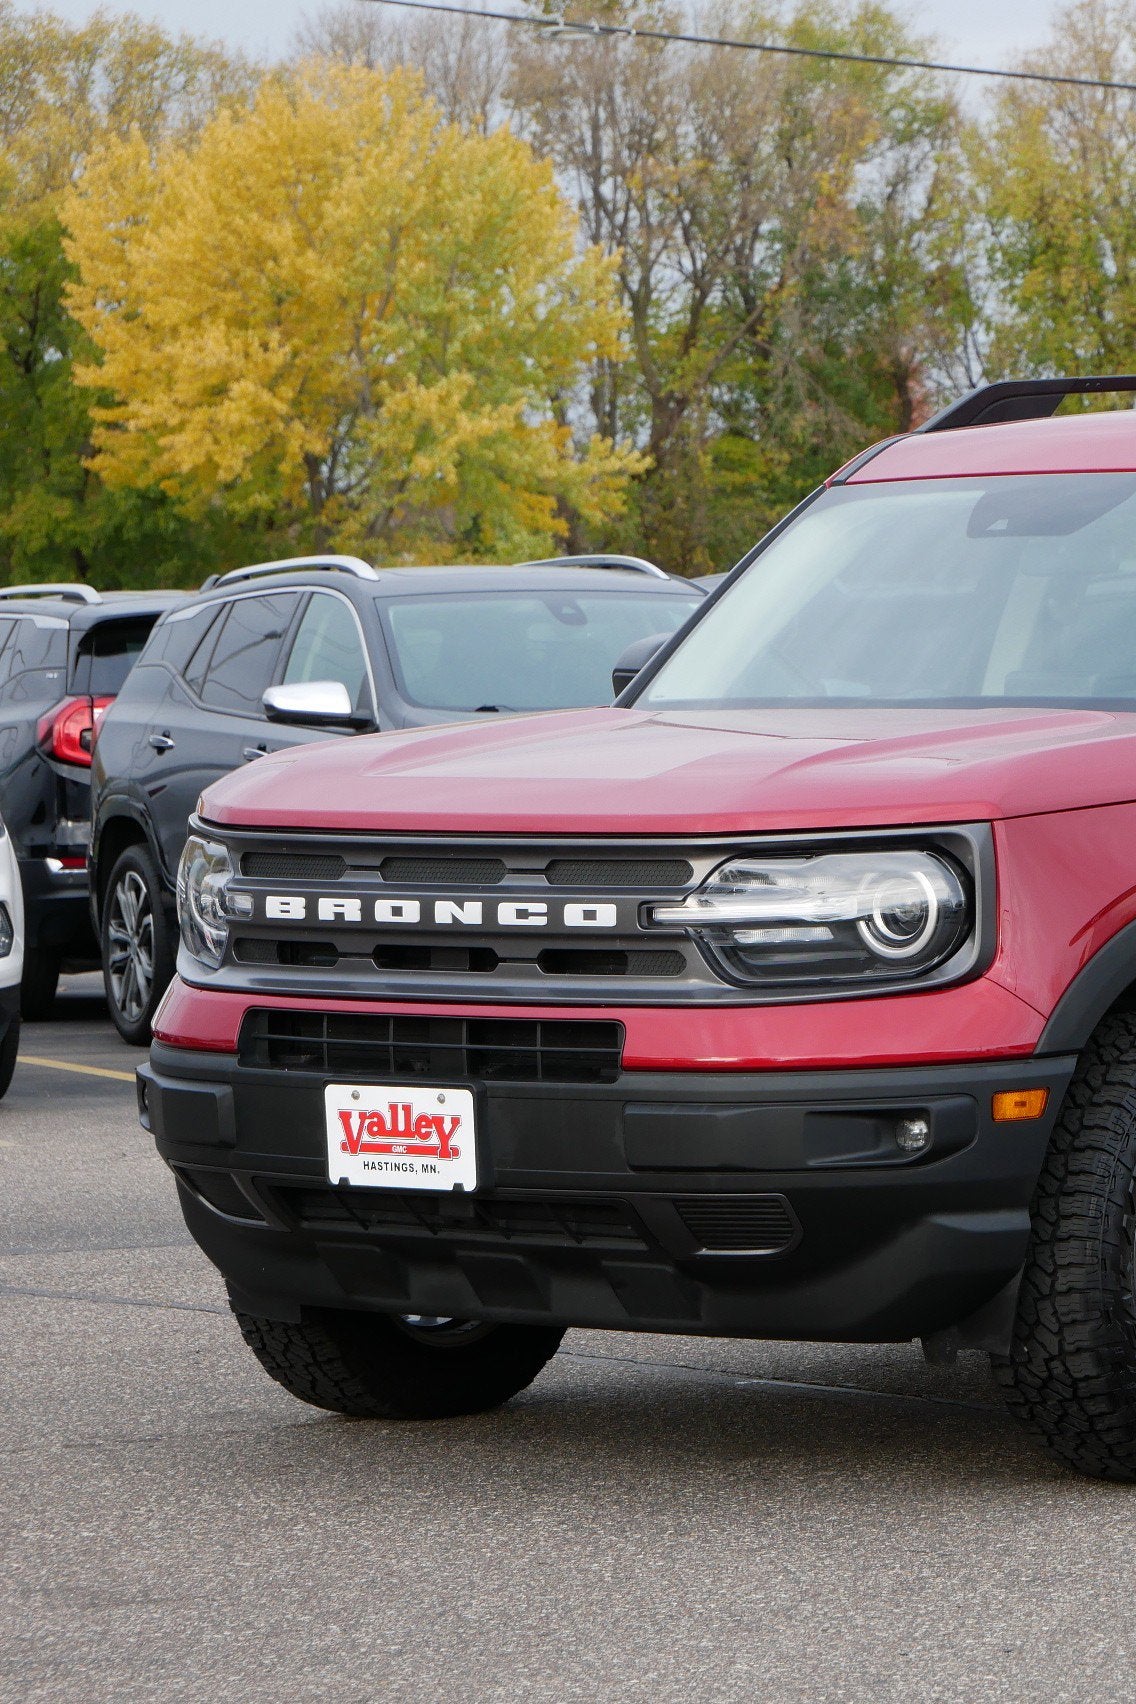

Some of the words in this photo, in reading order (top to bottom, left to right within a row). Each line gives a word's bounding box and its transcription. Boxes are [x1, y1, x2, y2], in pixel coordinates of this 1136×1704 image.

[265, 895, 617, 927] BRONCO
[338, 1102, 461, 1159] Valley
[391, 1145, 407, 1154] GMC
[363, 1161, 418, 1174] HASTINGS,
[421, 1164, 440, 1174] MN.
